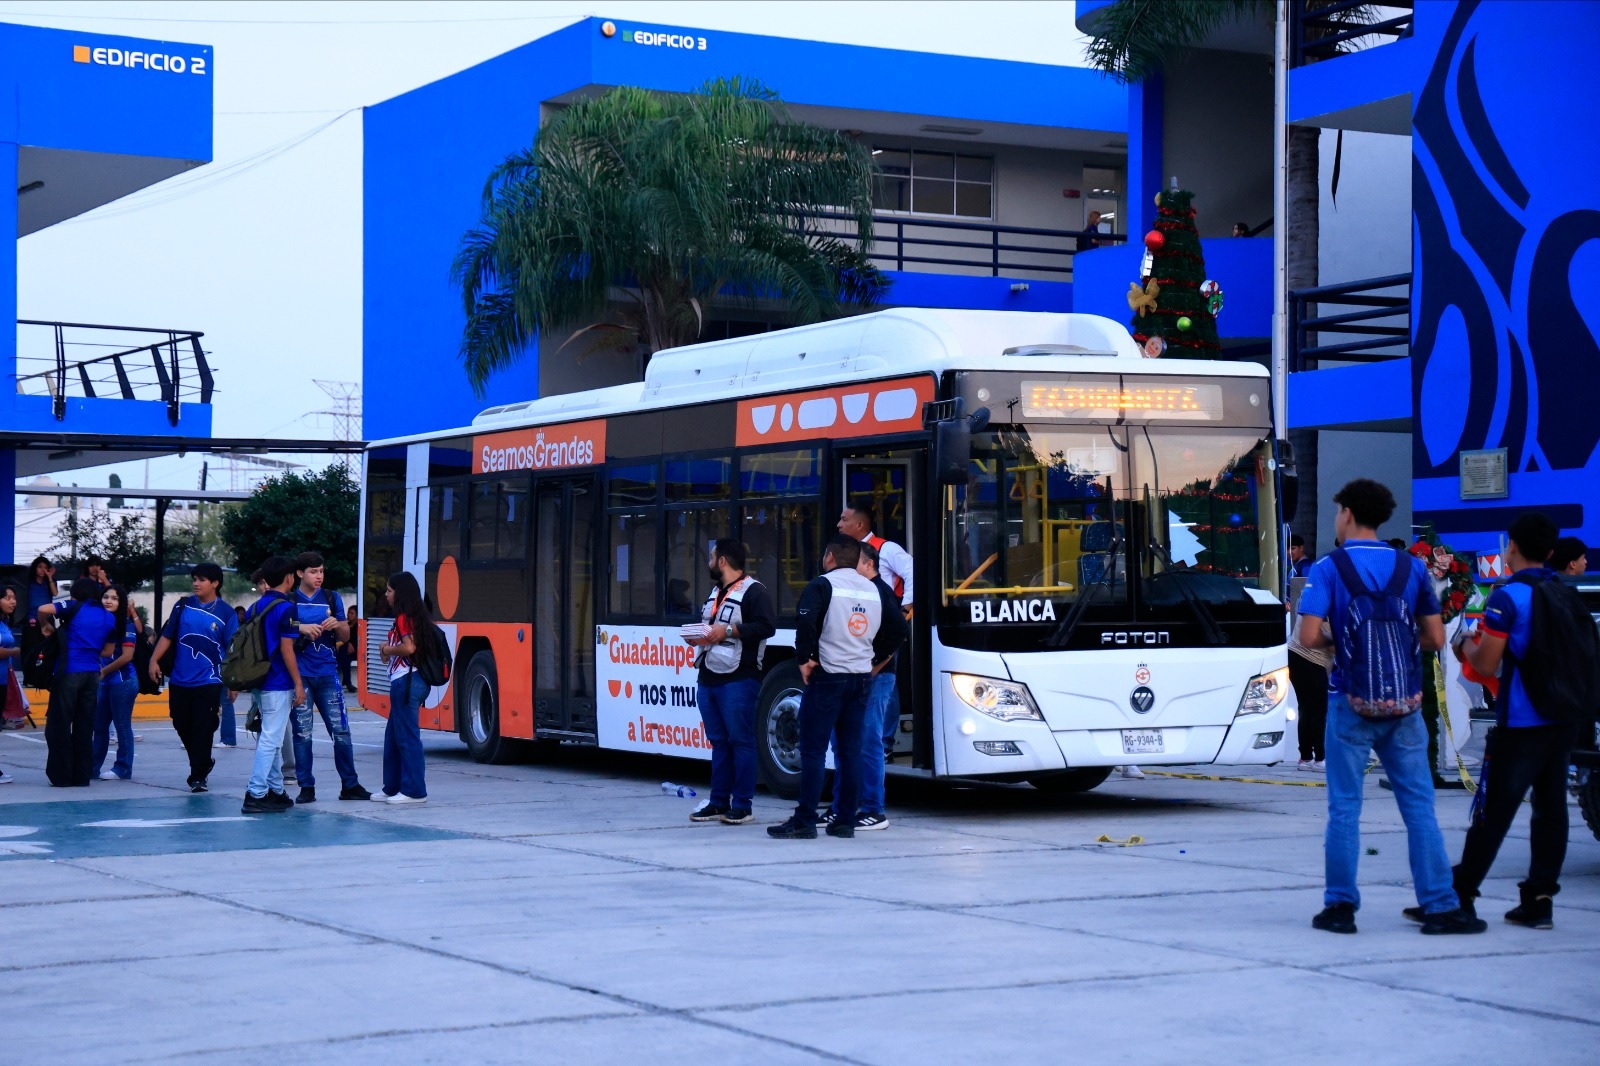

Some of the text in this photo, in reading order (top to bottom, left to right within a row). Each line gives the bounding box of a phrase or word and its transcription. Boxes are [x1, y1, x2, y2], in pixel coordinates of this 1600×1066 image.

[634, 30, 707, 50] EDIFICIO 3
[92, 47, 206, 75] EDIFICIO 2
[481, 435, 593, 473] SeamosGrandes
[970, 599, 1056, 623] BLANCA
[1101, 631, 1170, 644] FOTON
[609, 634, 695, 675] Guadalupe
[640, 683, 666, 706] nos
[627, 721, 636, 742] a
[640, 715, 654, 743] la
